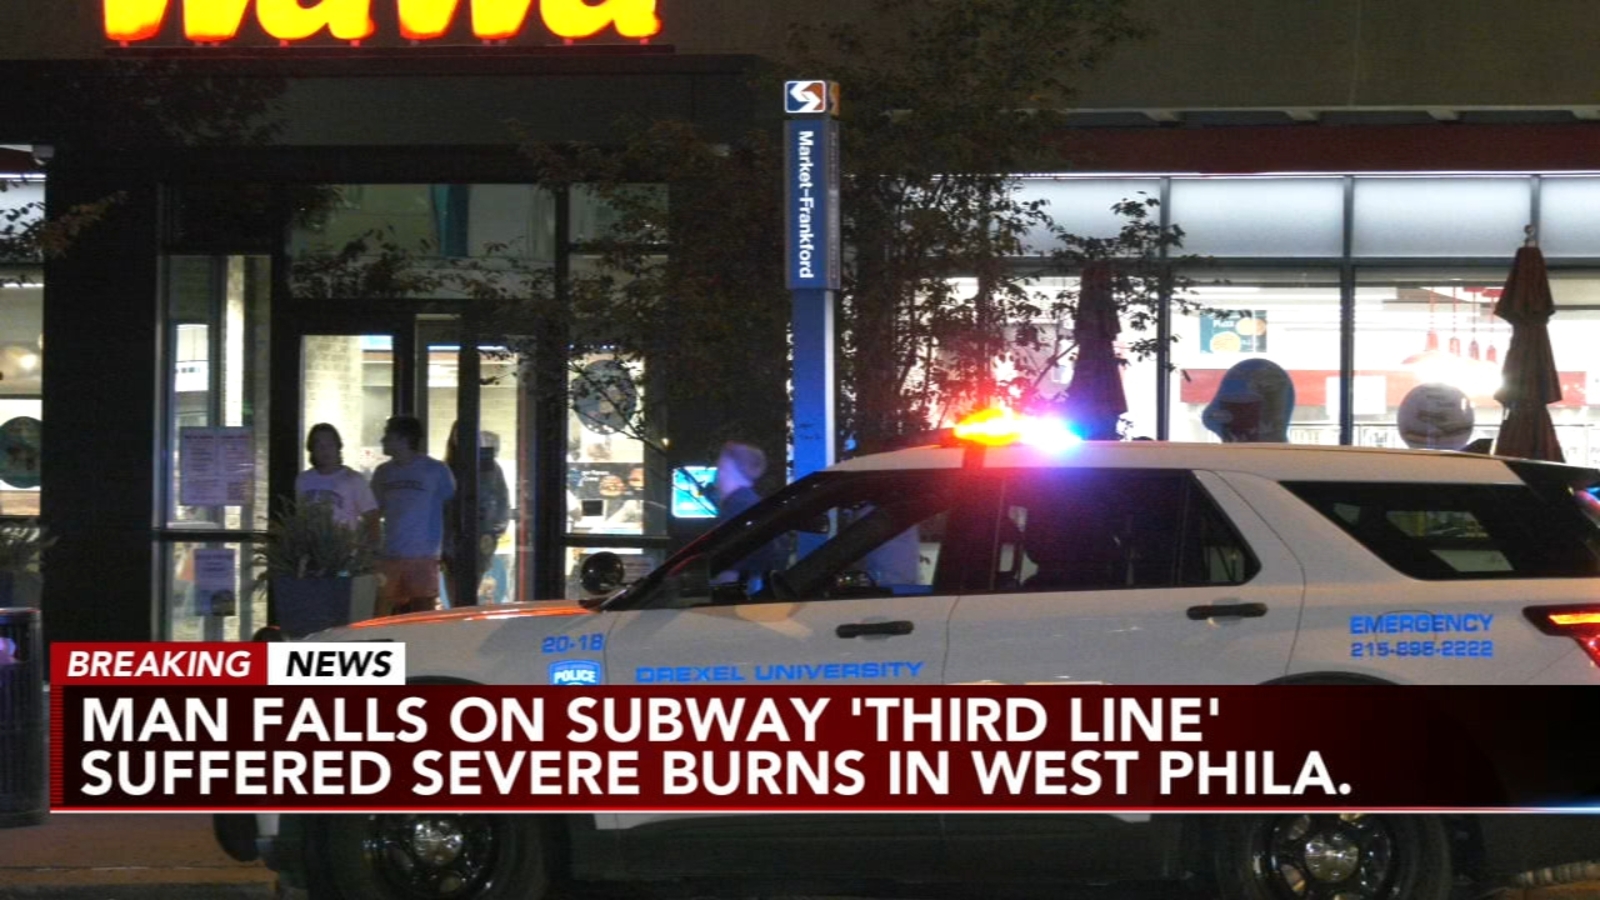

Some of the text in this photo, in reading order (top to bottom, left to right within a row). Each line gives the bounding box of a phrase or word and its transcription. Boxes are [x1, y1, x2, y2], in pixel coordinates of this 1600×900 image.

[798, 130, 815, 279] Market-Frankford
[1350, 613, 1494, 635] EMERGENCY
[541, 633, 605, 654] 20-18
[553, 669, 596, 684] POLICE
[634, 661, 924, 683] DREXEL UNIVERSITY
